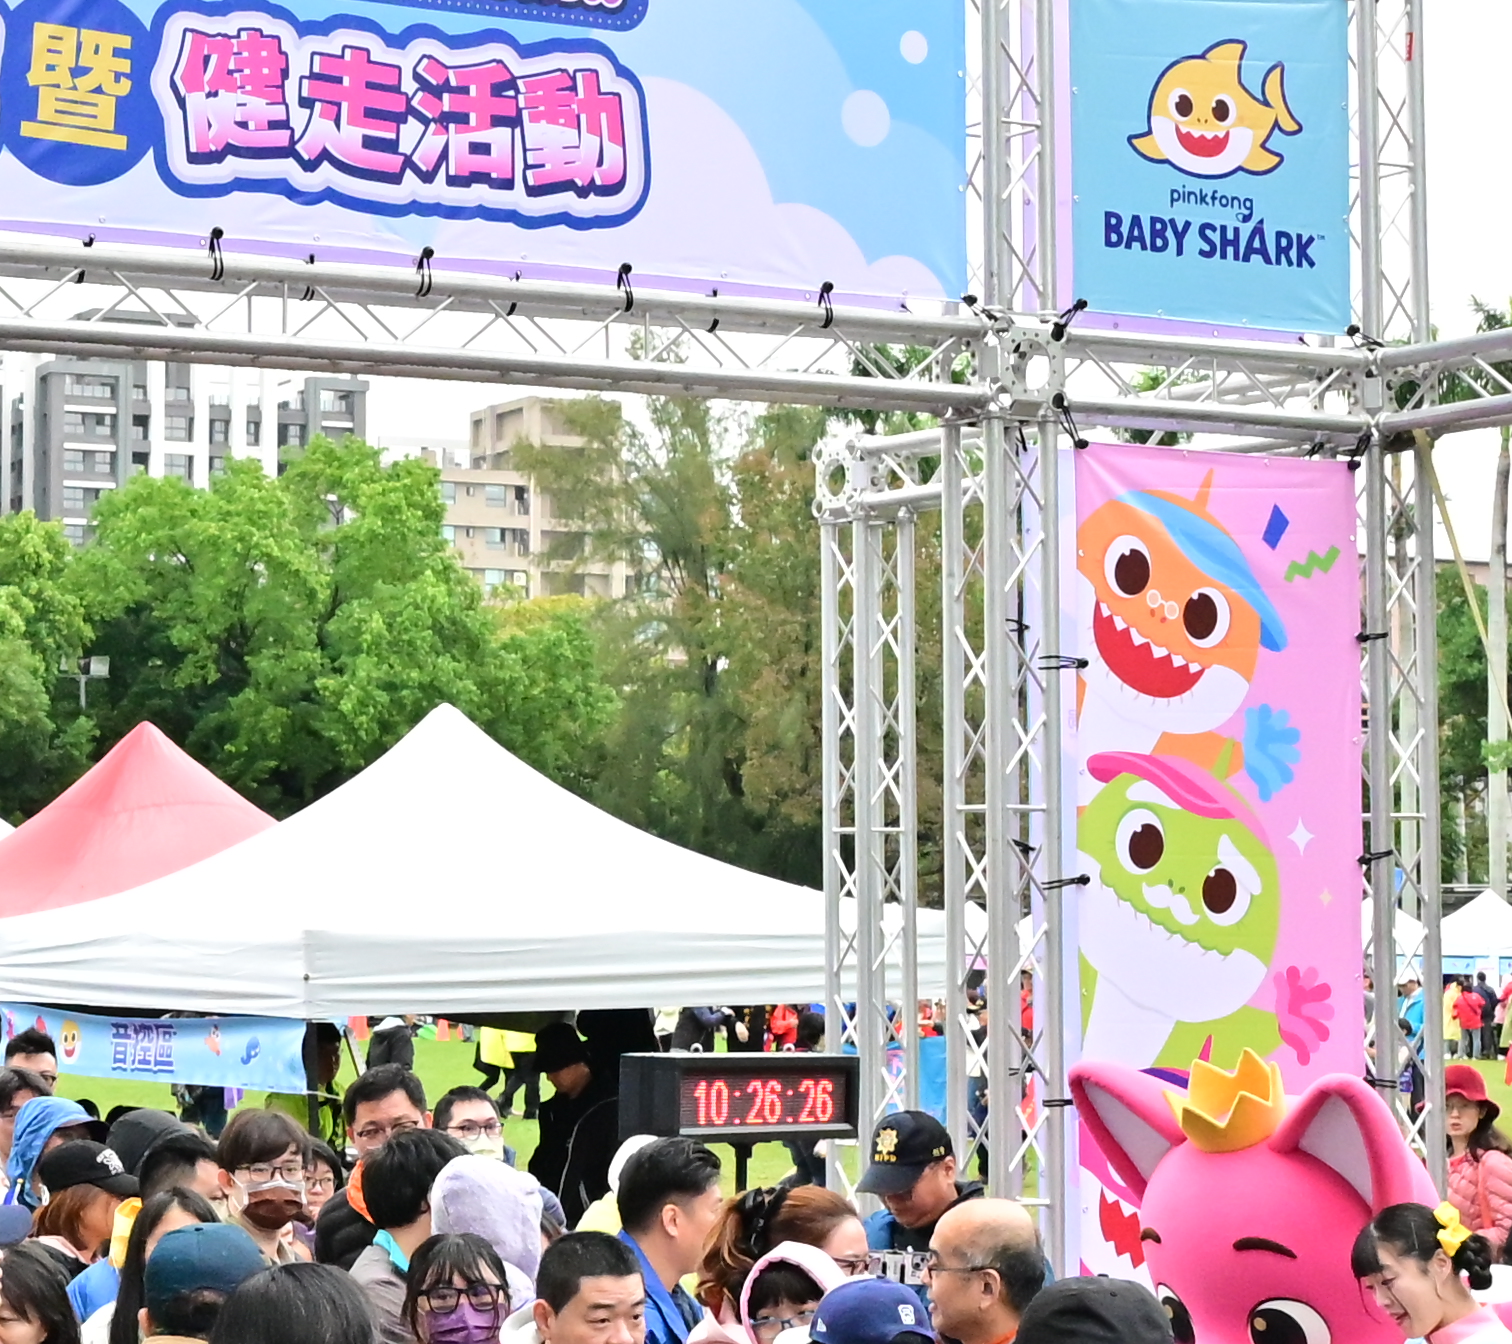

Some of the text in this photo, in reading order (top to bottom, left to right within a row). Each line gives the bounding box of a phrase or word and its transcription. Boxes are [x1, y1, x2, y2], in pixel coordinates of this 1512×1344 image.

[1167, 183, 1255, 223] pinkfong
[1103, 209, 1317, 271] BABY SHARK
[110, 1021, 178, 1073] 音控區
[693, 1078, 834, 1125] 10:26:26
